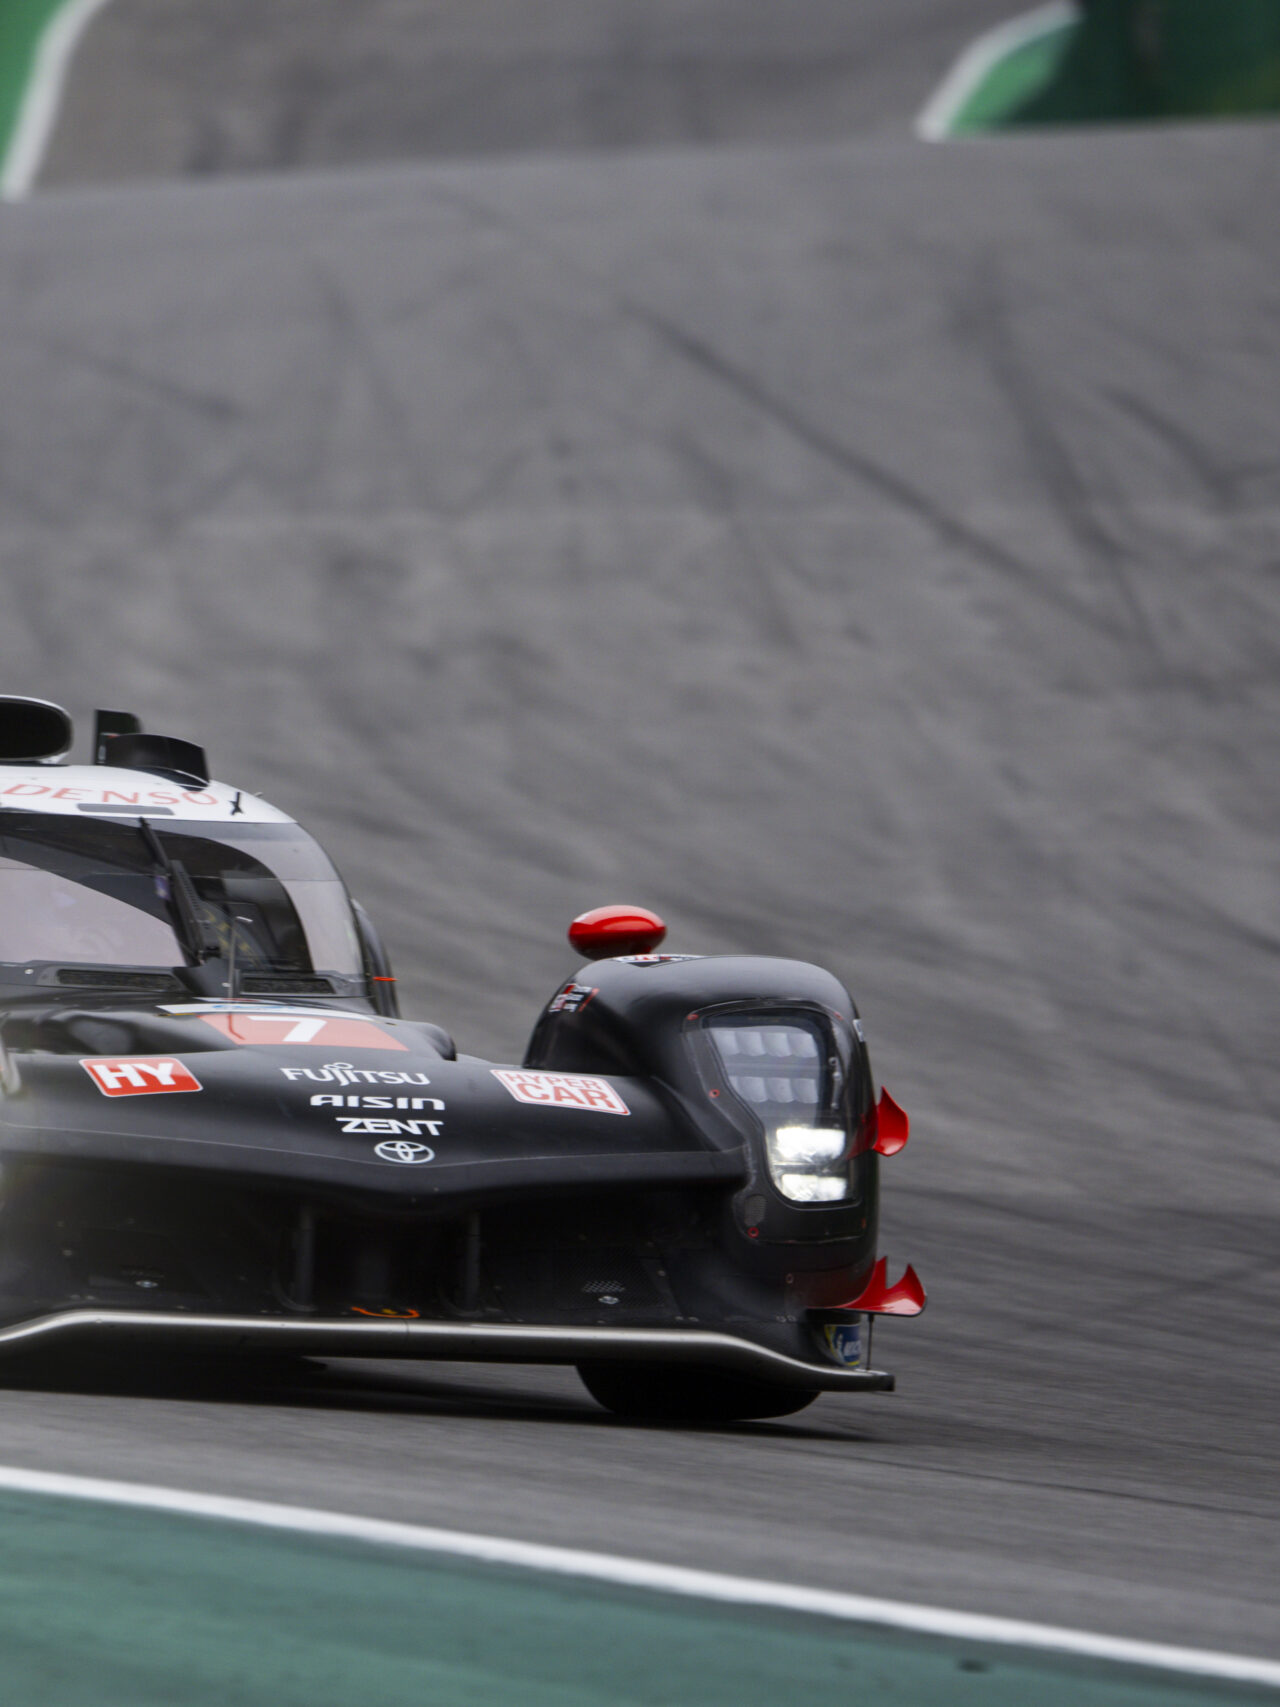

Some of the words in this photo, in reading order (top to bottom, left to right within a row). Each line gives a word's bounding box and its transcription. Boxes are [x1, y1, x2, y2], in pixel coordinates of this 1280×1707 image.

[1, 783, 220, 806] DENSO
[246, 1015, 327, 1043] 7
[91, 1061, 176, 1089] HY
[279, 1065, 431, 1087] FUJITSU
[505, 1073, 602, 1091] HYPER
[310, 1094, 446, 1111] AISIN
[517, 1083, 617, 1109] CAR
[335, 1117, 444, 1136] ZENT
